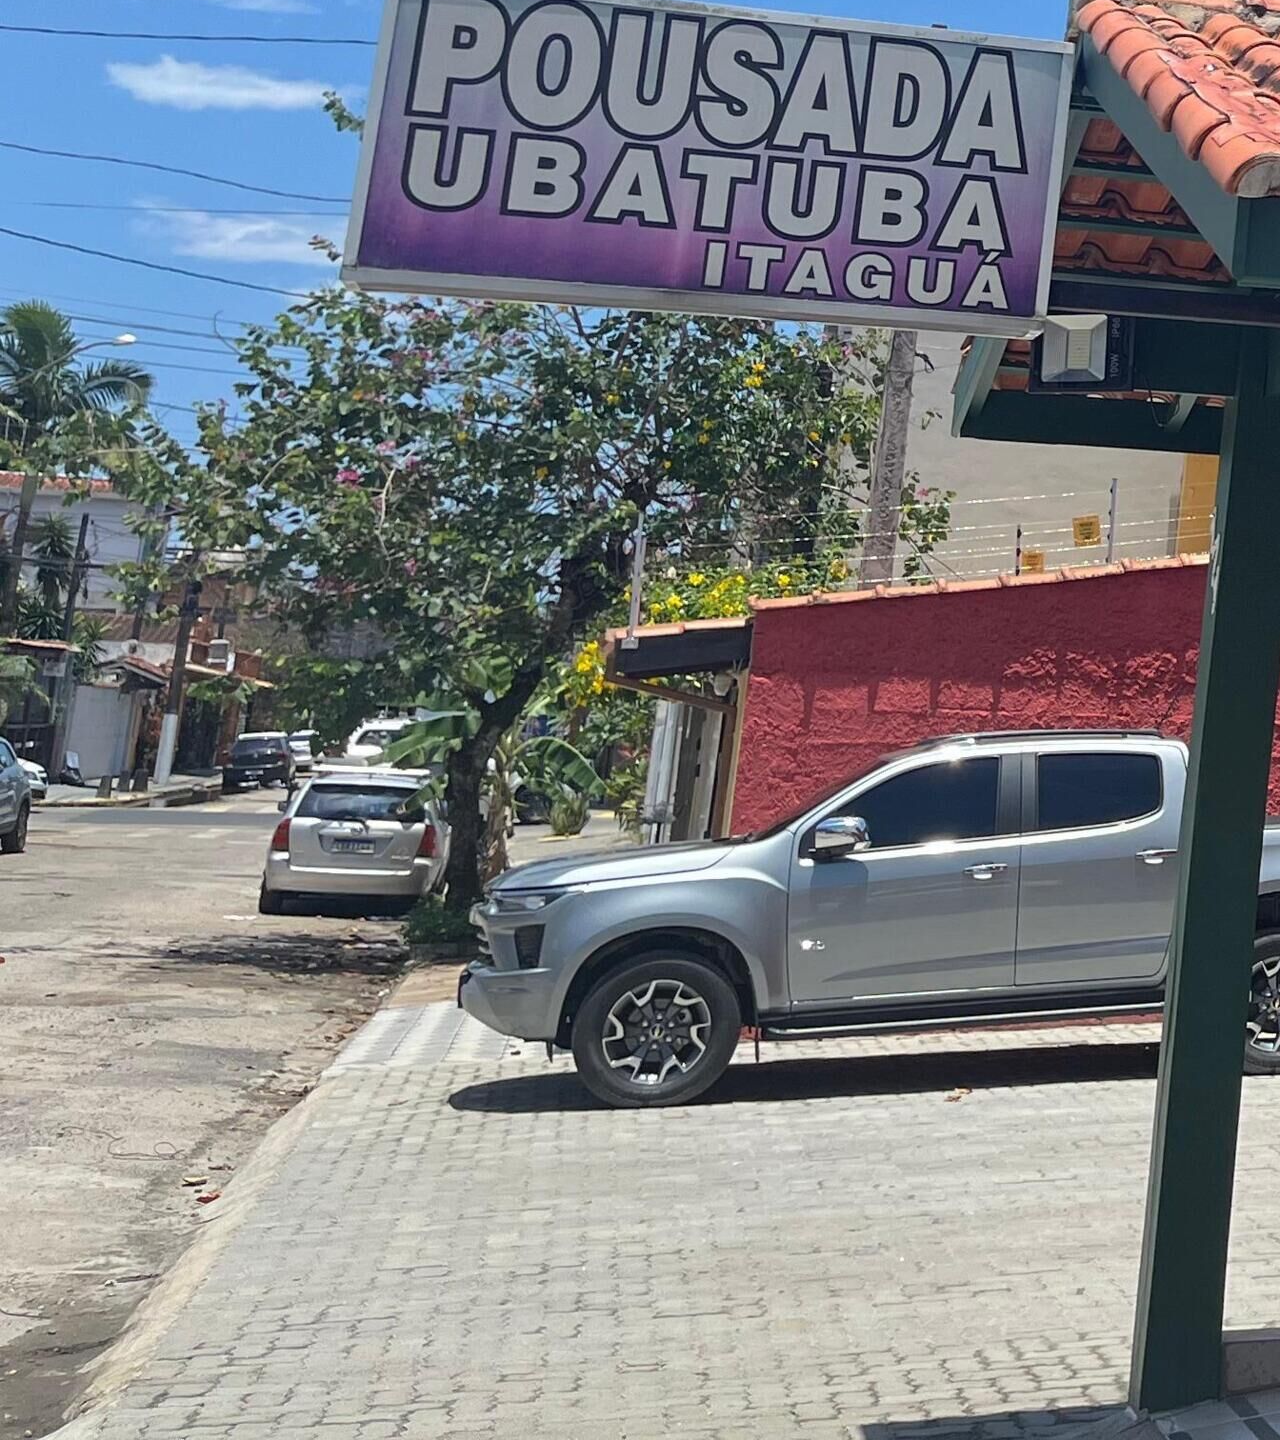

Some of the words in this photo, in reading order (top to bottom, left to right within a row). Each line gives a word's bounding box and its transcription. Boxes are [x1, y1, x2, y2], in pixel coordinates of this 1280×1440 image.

[401, 123, 1013, 257] UBATUBA
[702, 239, 1010, 311] ITAGUÁ
[1109, 353, 1120, 378] 100W
